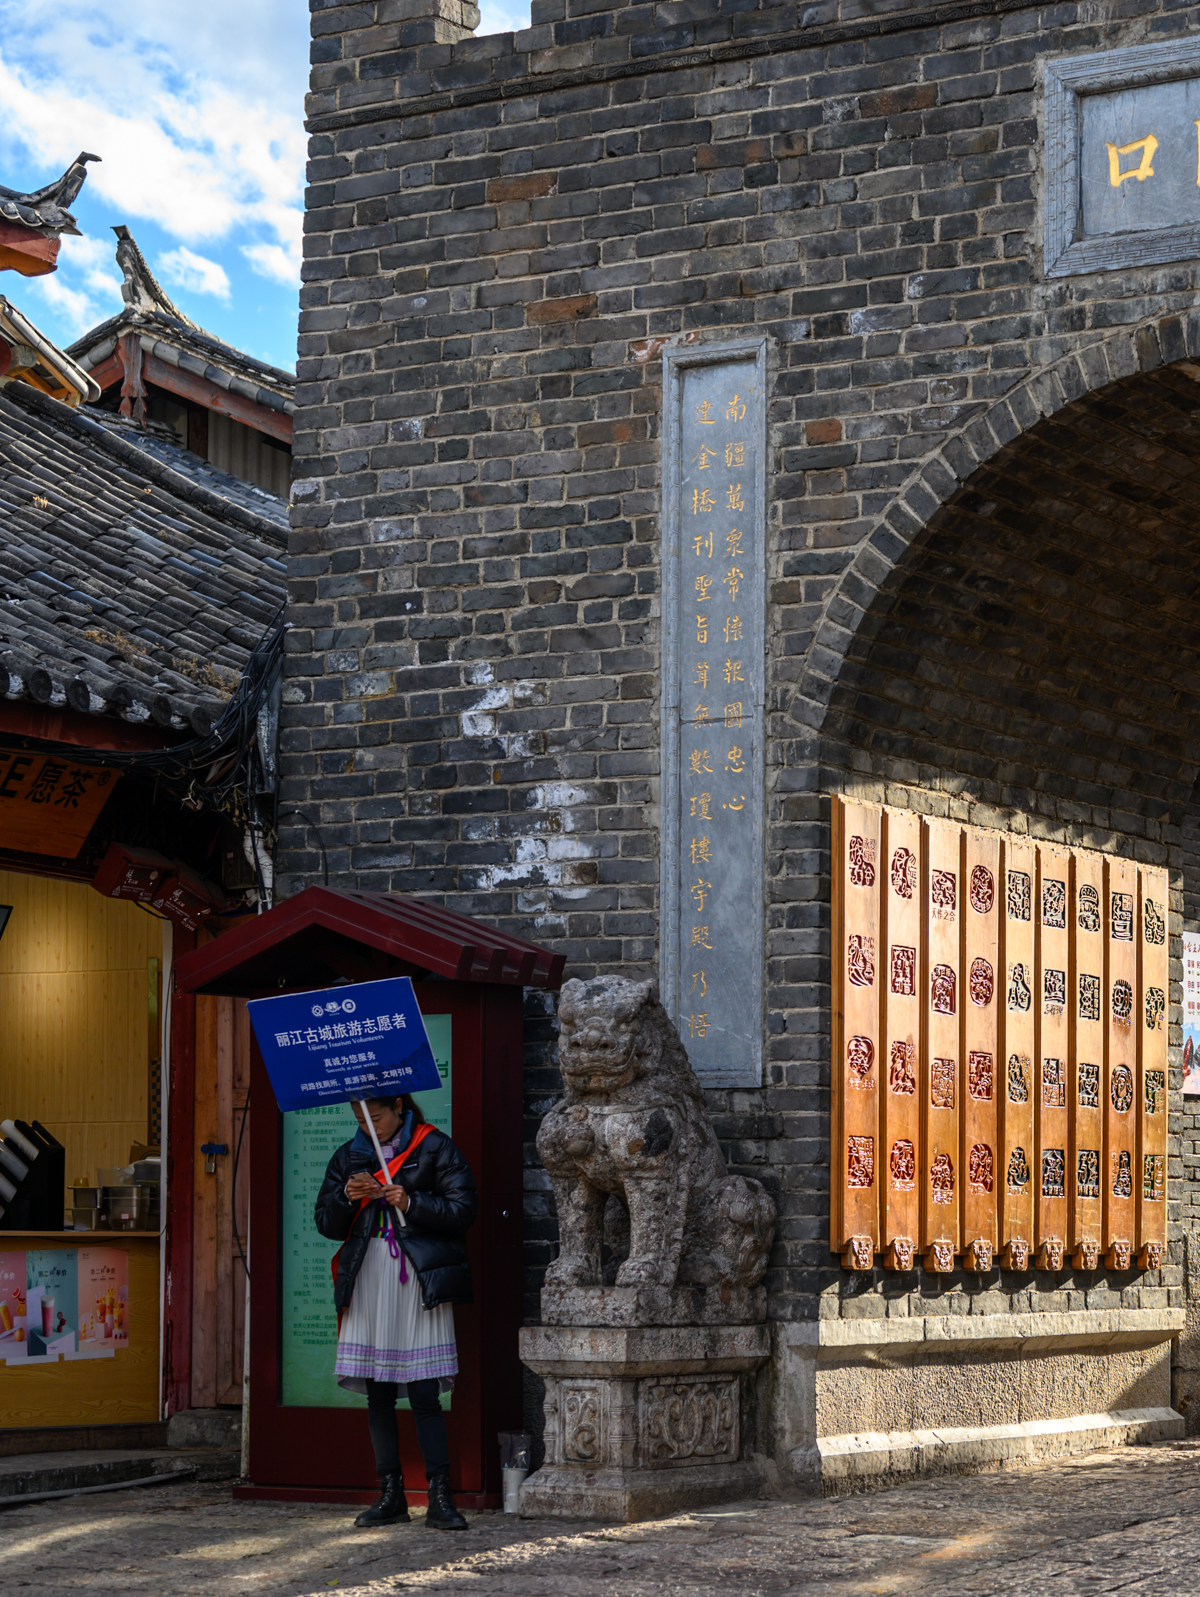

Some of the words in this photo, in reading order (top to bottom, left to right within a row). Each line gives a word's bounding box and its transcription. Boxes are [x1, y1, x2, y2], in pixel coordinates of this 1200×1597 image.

[25, 762, 93, 808] 愿茶
[274, 1012, 407, 1048] 丽江古城旅游志愿者
[307, 1043, 328, 1052] Lijiang
[328, 1039, 352, 1048] Tourism
[352, 1034, 384, 1044] Volunteers
[323, 1051, 377, 1068] 真诚为您服务
[382, 1066, 413, 1079] 文明引导
